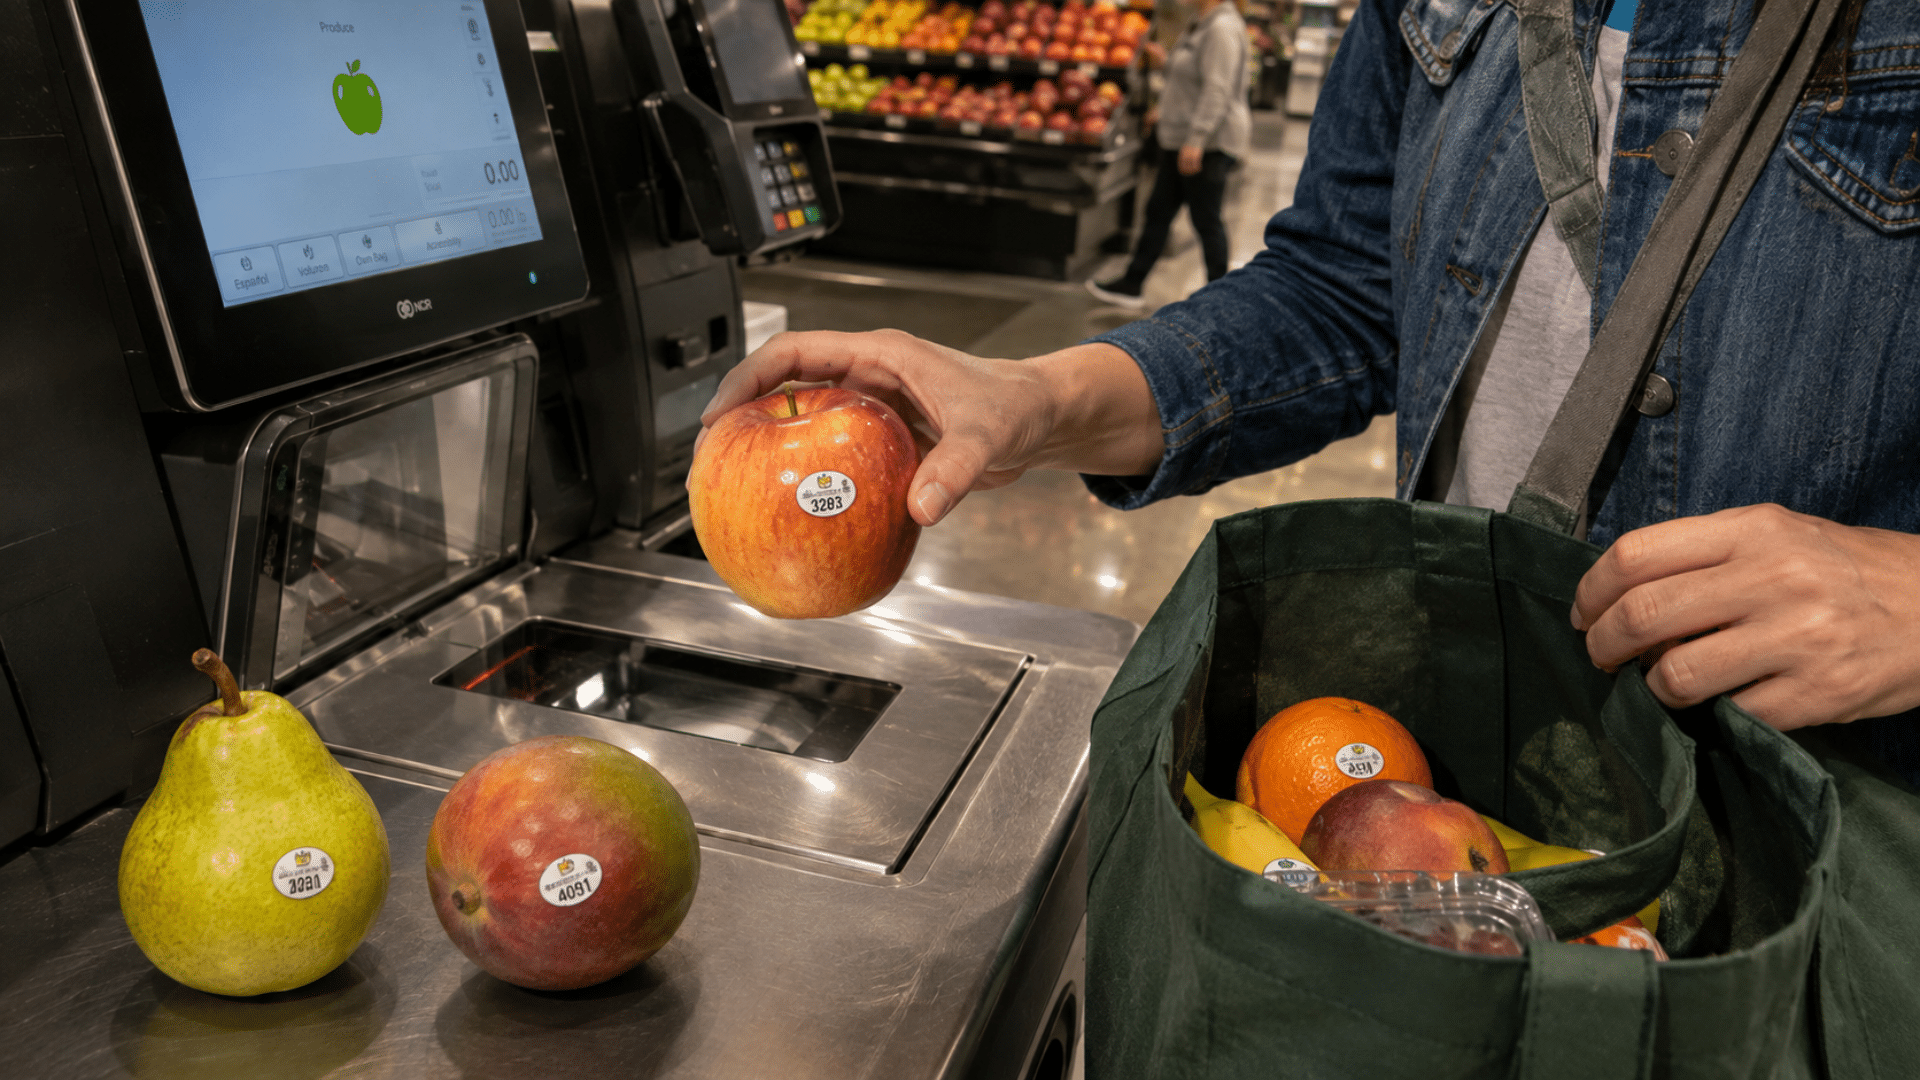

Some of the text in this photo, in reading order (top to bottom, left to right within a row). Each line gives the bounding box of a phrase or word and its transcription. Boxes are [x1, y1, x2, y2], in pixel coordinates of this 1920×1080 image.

[319, 21, 355, 33] Produce
[484, 159, 519, 185] 0.00
[487, 207, 515, 228] 0.00
[413, 298, 432, 312] NCR
[811, 496, 843, 512] 3283
[559, 877, 591, 901] 4091
